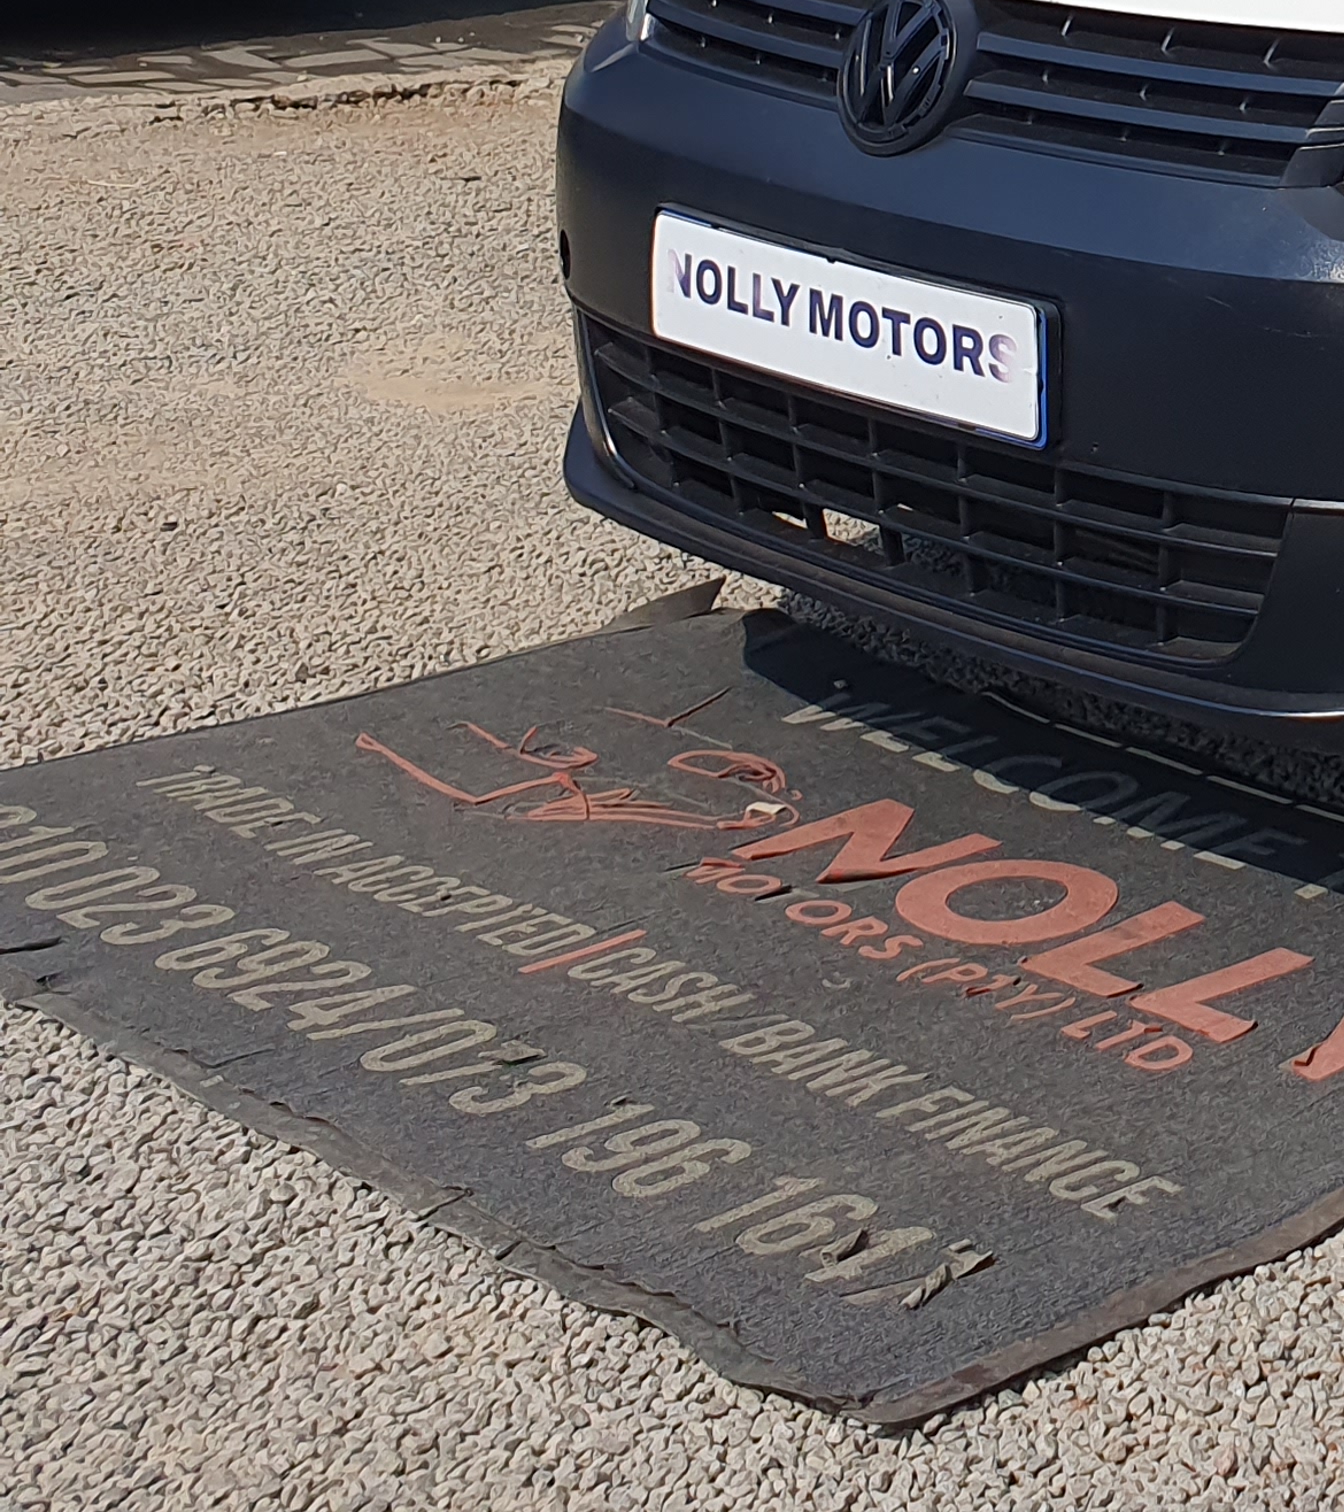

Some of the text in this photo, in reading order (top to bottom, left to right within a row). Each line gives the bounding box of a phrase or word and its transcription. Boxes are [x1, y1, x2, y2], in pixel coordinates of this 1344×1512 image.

[666, 248, 1018, 385] NOLLY MOTORS
[782, 693, 1309, 870] WELCOME
[136, 765, 322, 839] TRADE
[263, 827, 374, 866] IN
[875, 1085, 1183, 1222] FINANCE
[1060, 1009, 1195, 1072] LTD
[525, 1100, 753, 1197] 196
